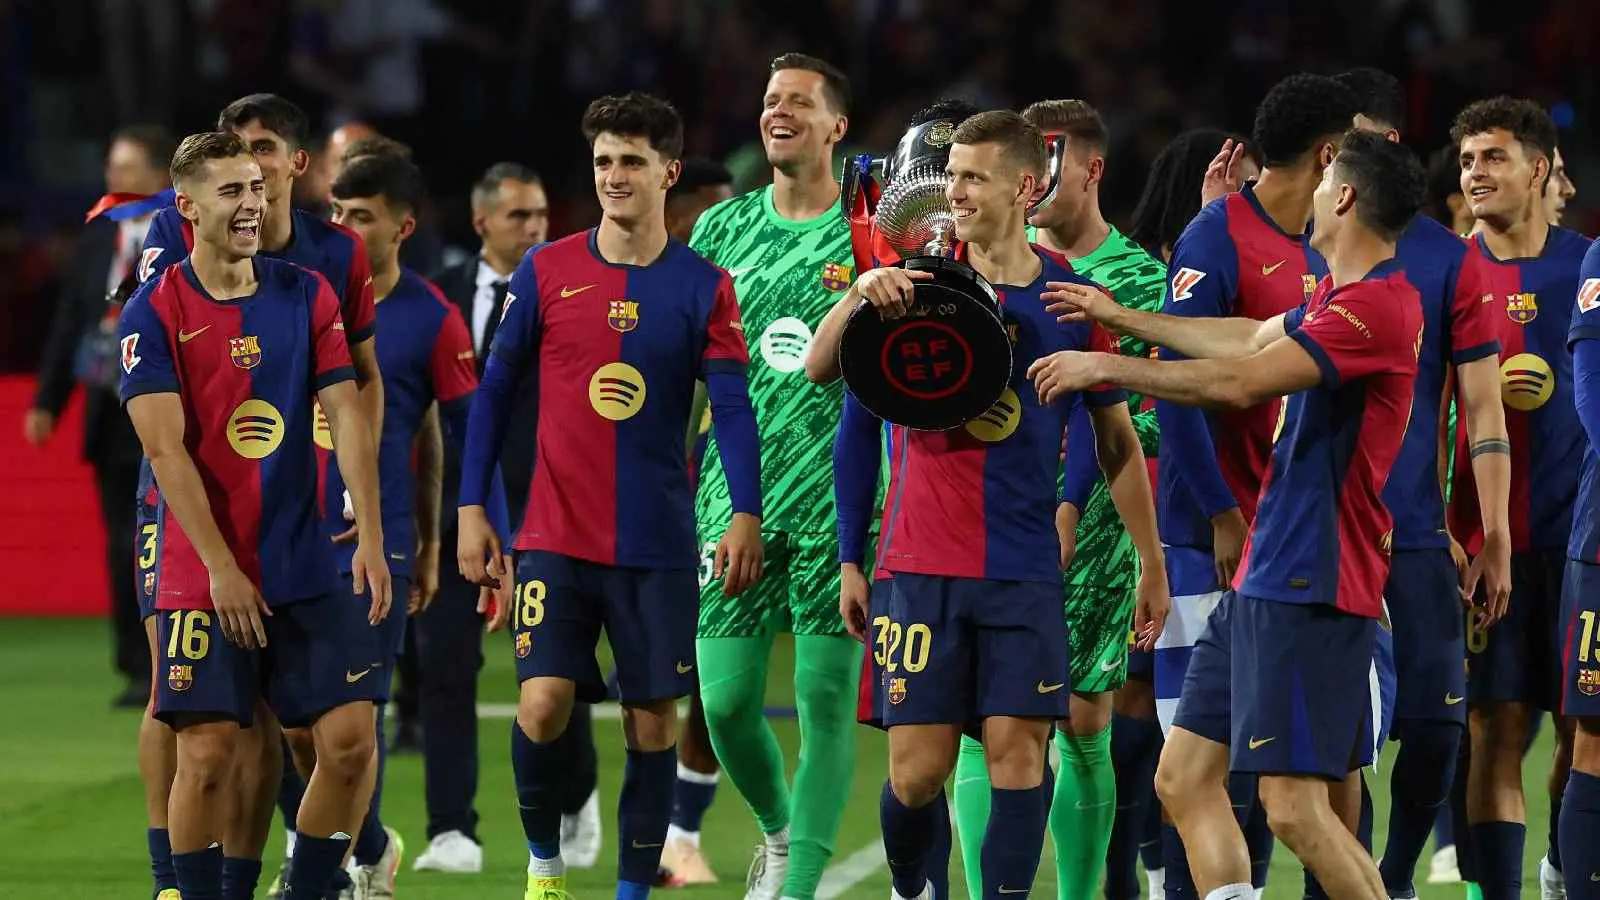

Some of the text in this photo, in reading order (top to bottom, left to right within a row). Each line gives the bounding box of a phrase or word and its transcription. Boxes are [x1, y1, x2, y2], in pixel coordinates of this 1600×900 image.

[138, 523, 158, 570] 3
[514, 579, 547, 632] 18
[167, 609, 210, 661] 16
[886, 621, 933, 674] 20
[1578, 610, 1600, 663] 1
